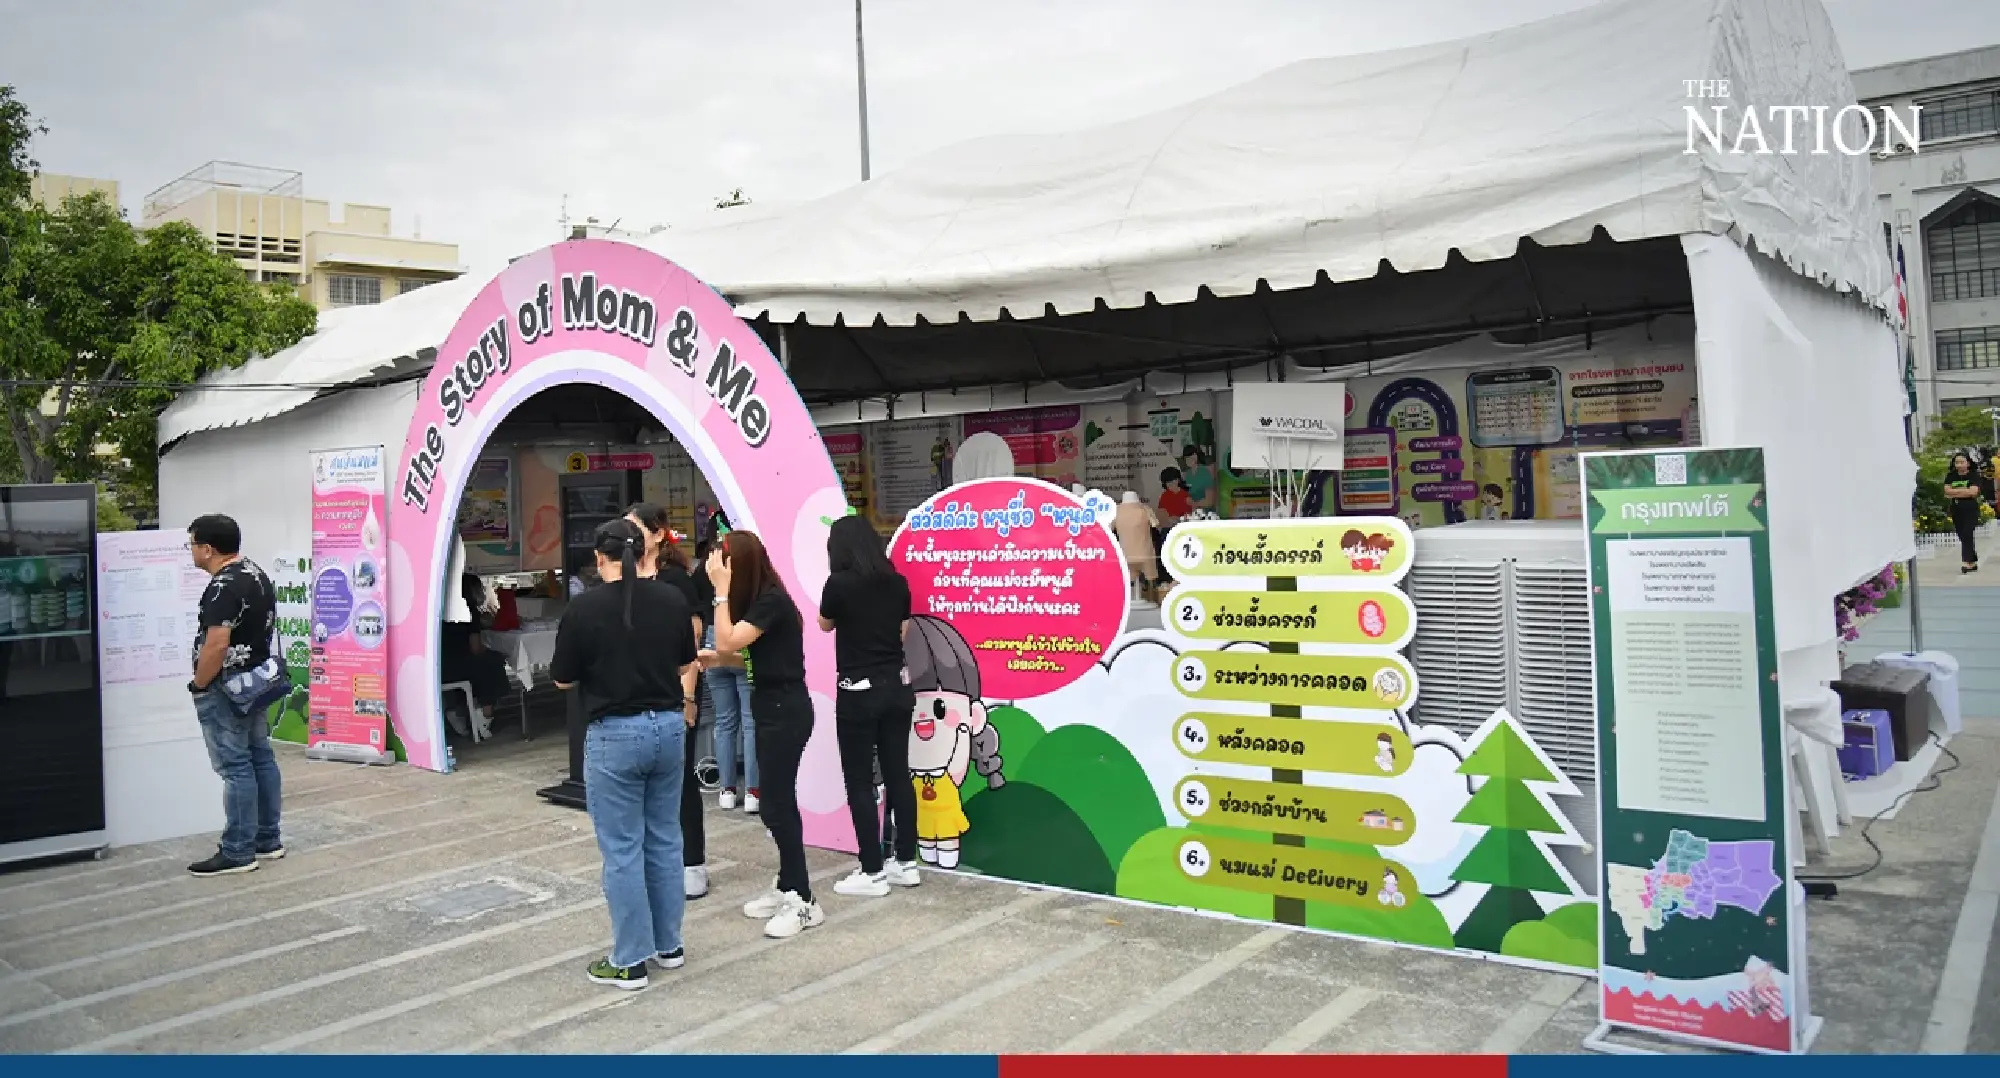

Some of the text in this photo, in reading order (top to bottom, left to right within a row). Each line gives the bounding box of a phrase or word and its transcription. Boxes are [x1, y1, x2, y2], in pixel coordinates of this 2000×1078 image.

[402, 271, 771, 512] The Story of Mom & Me
[1274, 416, 1327, 430] WACOAL
[572, 457, 582, 470] 3
[911, 501, 977, 530] สวัสดีค่ะ
[983, 490, 1034, 536] หนูชื่อ
[1621, 493, 1728, 525] กรุงเทพใต้
[1213, 533, 1324, 564] ก่อนตั้งครรภ์
[1183, 597, 1317, 628] 2. ช่วงตั้งครรภ์
[1184, 664, 1367, 691] 3. ระหว่างการคลอด
[1185, 726, 1305, 755] 4. หลังคลอด
[1186, 789, 1327, 823] 5. ช่วงกลับบ้าน
[1186, 850, 1369, 896] 6. นมแม่ Delivery
